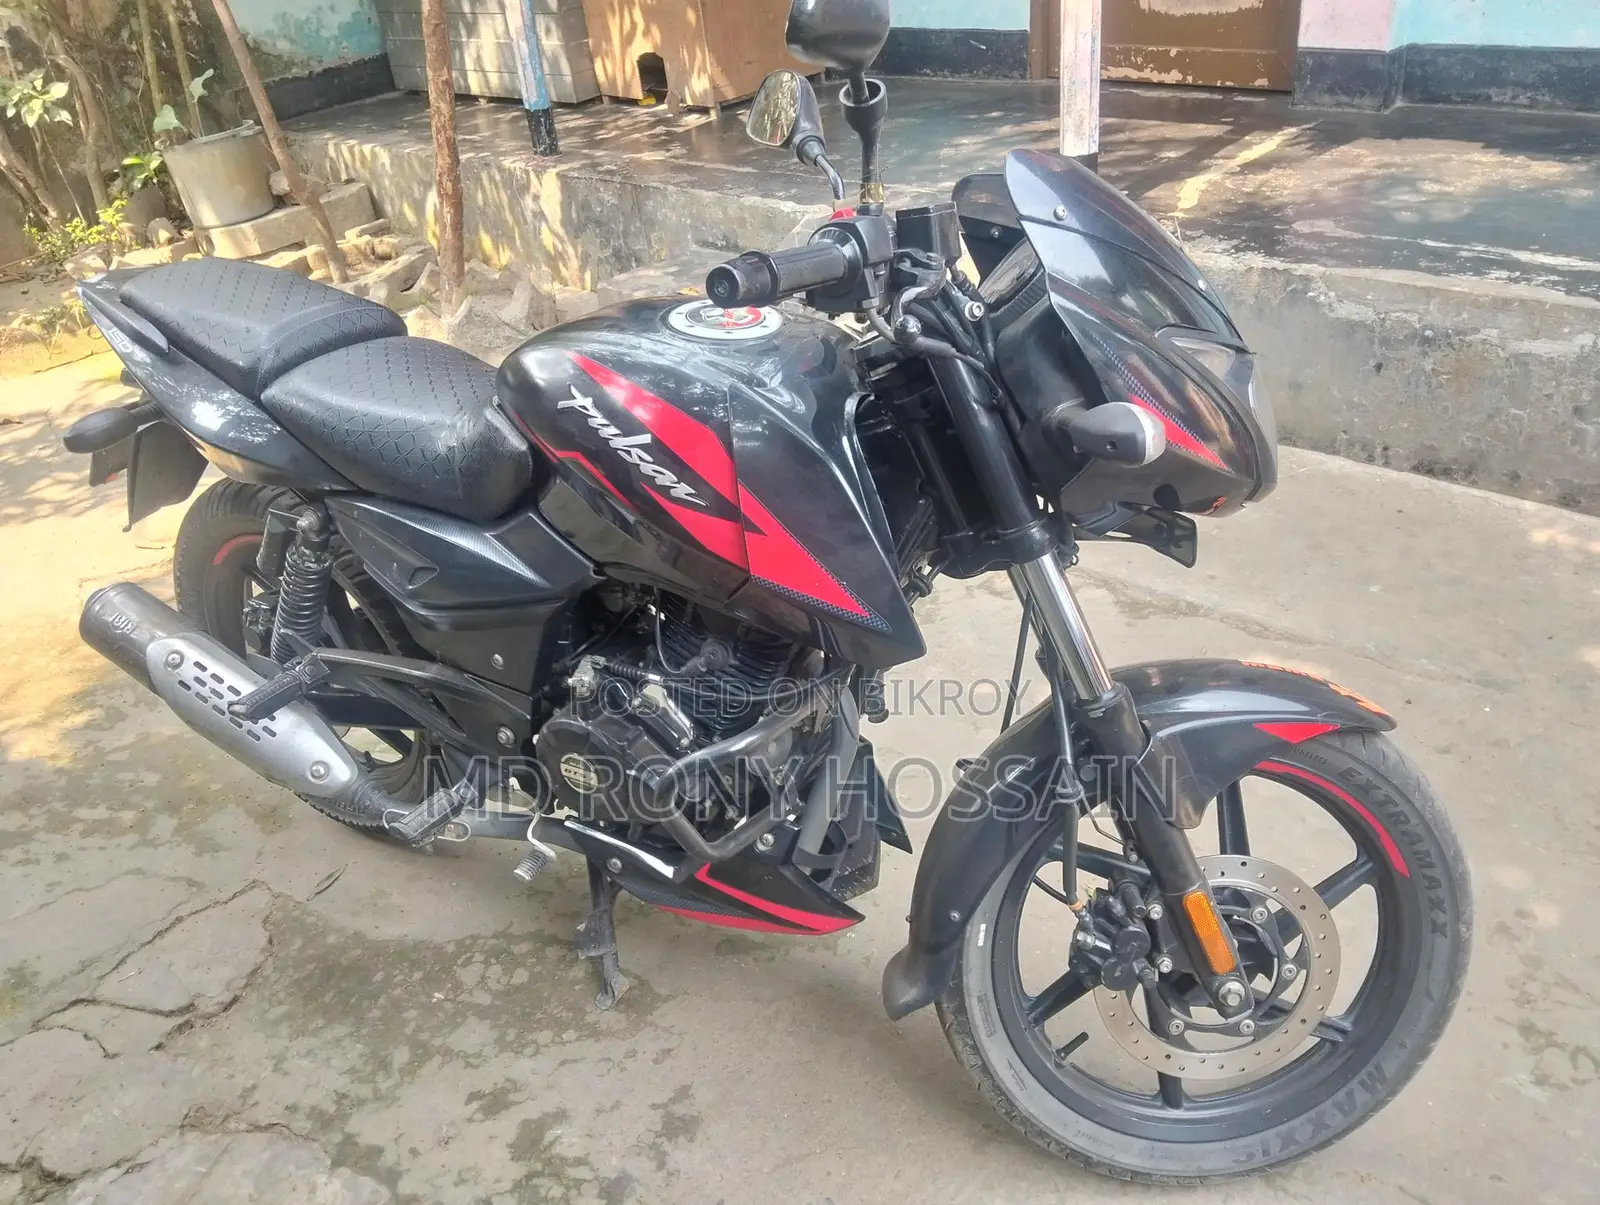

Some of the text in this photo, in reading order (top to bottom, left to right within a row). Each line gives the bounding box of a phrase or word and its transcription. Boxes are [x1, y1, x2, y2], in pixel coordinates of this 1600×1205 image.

[557, 382, 710, 507] Pulsar
[1337, 765, 1449, 940] EXTRAMAXX
[1231, 1061, 1389, 1165] MAXXIS
